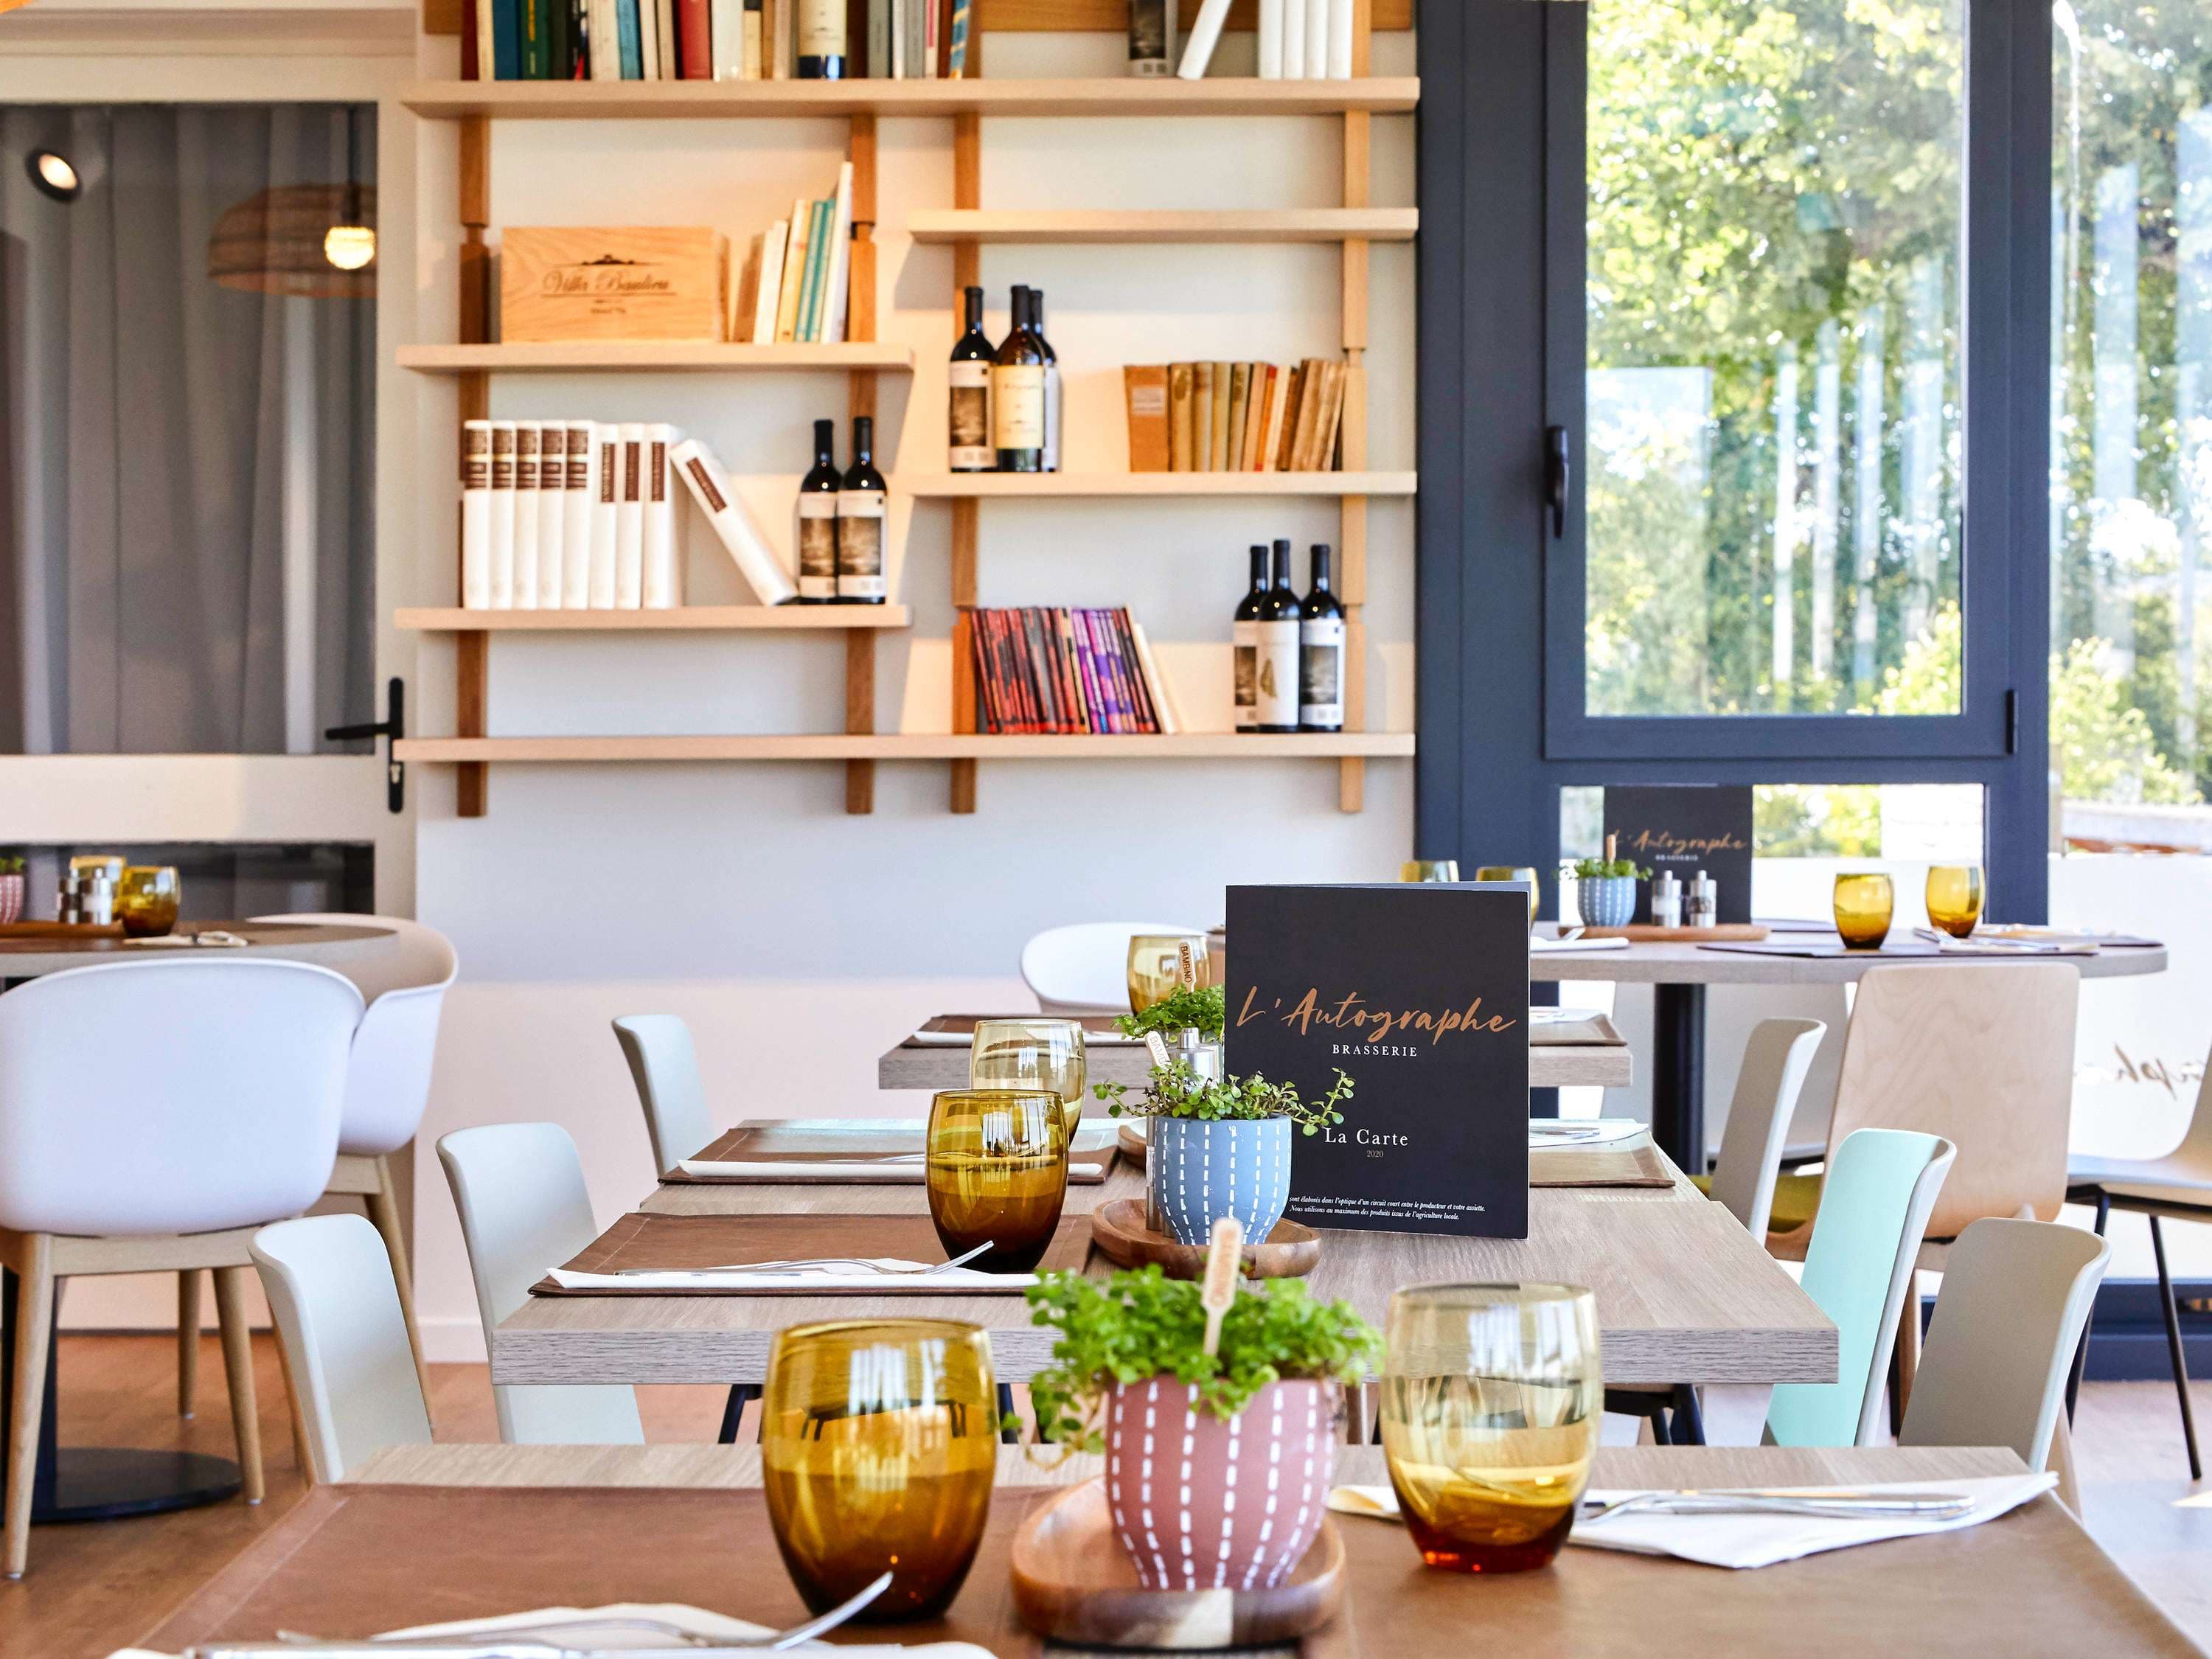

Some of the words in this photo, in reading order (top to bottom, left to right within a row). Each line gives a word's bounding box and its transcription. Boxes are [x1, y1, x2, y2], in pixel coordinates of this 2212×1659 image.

[1180, 946, 1192, 983] BAMBINO
[1237, 985, 1517, 1046] L'Autographe
[1332, 1044, 1418, 1057] BRASSERIE
[1324, 1127, 1347, 1144] La
[1356, 1128, 1408, 1147] Carte
[1366, 1150, 1384, 1158] 2020
[1301, 1195, 1321, 1203] élaborés
[1335, 1197, 1357, 1206] l'optique
[1419, 1201, 1447, 1210] producteur
[1466, 1203, 1485, 1211] assiette.
[1304, 1205, 1325, 1213] utilisons
[1369, 1209, 1391, 1217] produits
[1412, 1211, 1443, 1220] l'agriculture
